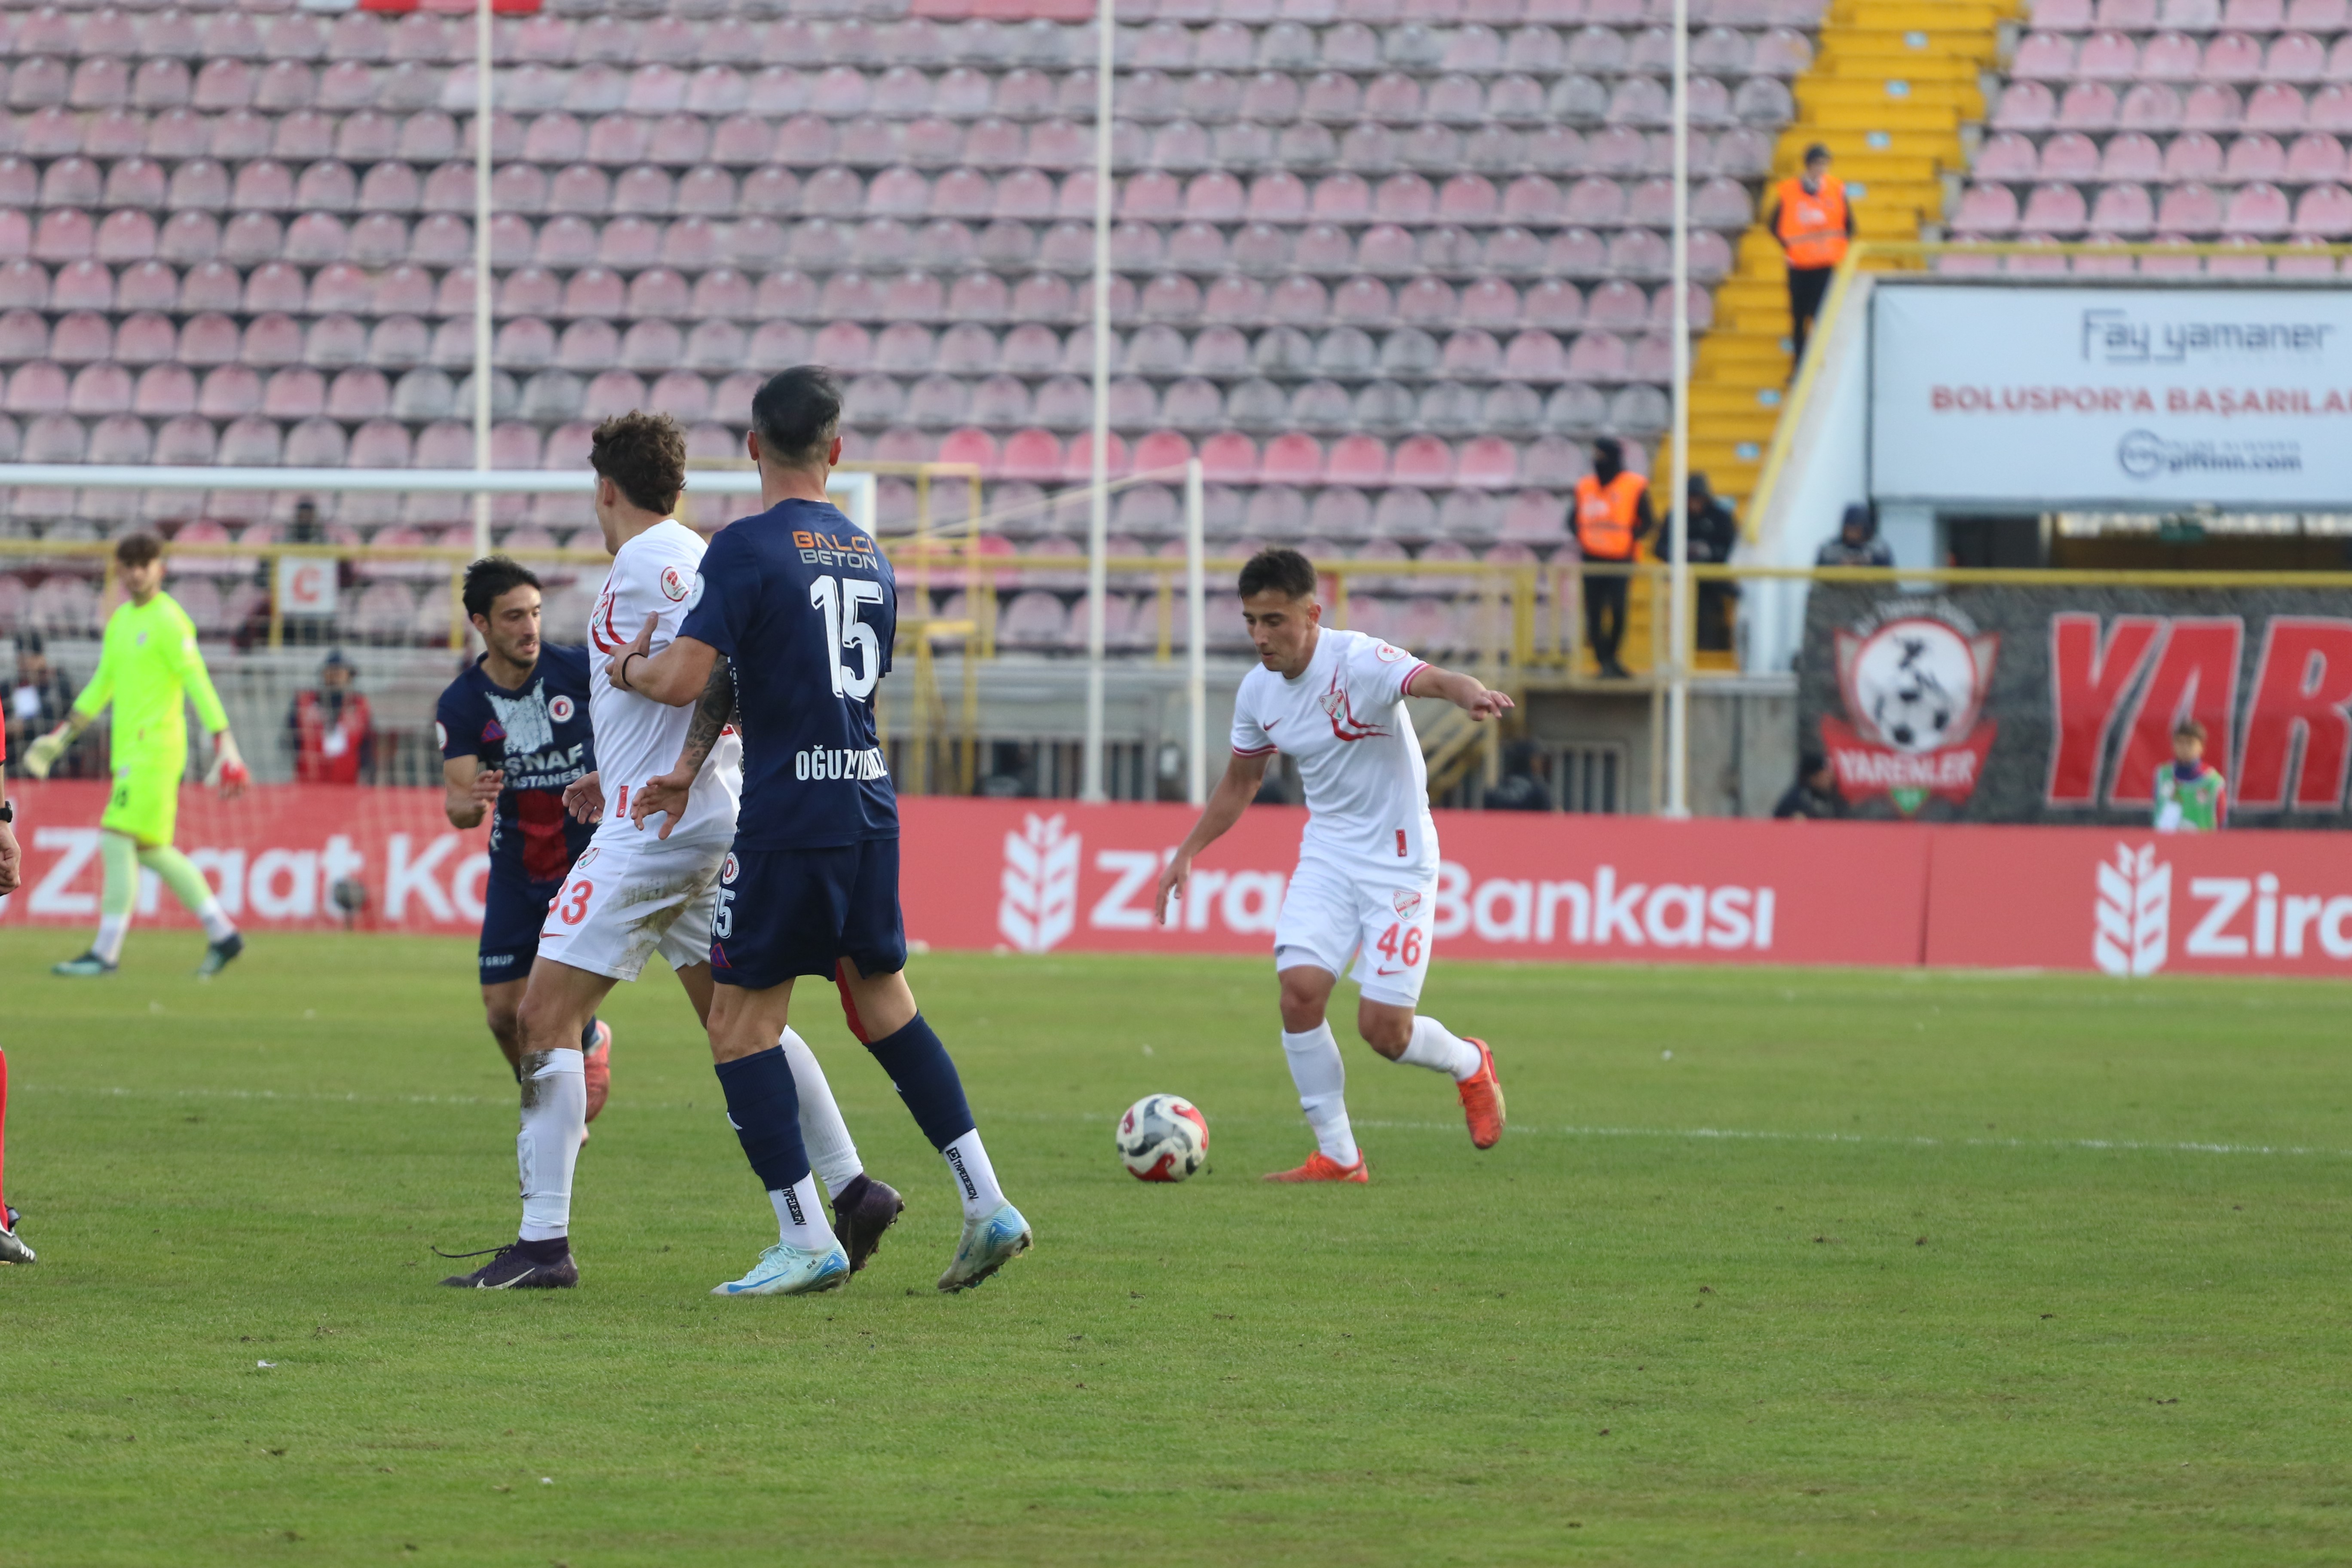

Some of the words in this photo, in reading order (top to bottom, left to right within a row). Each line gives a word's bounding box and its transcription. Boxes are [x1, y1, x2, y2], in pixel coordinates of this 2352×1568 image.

[1930, 385, 2156, 413] BOLUSPOR'A
[2167, 386, 2352, 417] BAŞARILA
[792, 530, 874, 553] BALCI
[799, 548, 879, 570] BETON
[292, 567, 322, 602] C
[810, 575, 884, 703] 15
[28, 827, 365, 922] Zraat
[1435, 863, 1774, 951] Bankası
[1376, 921, 1423, 967] 46
[953, 1159, 980, 1199] TAPEDESIGN
